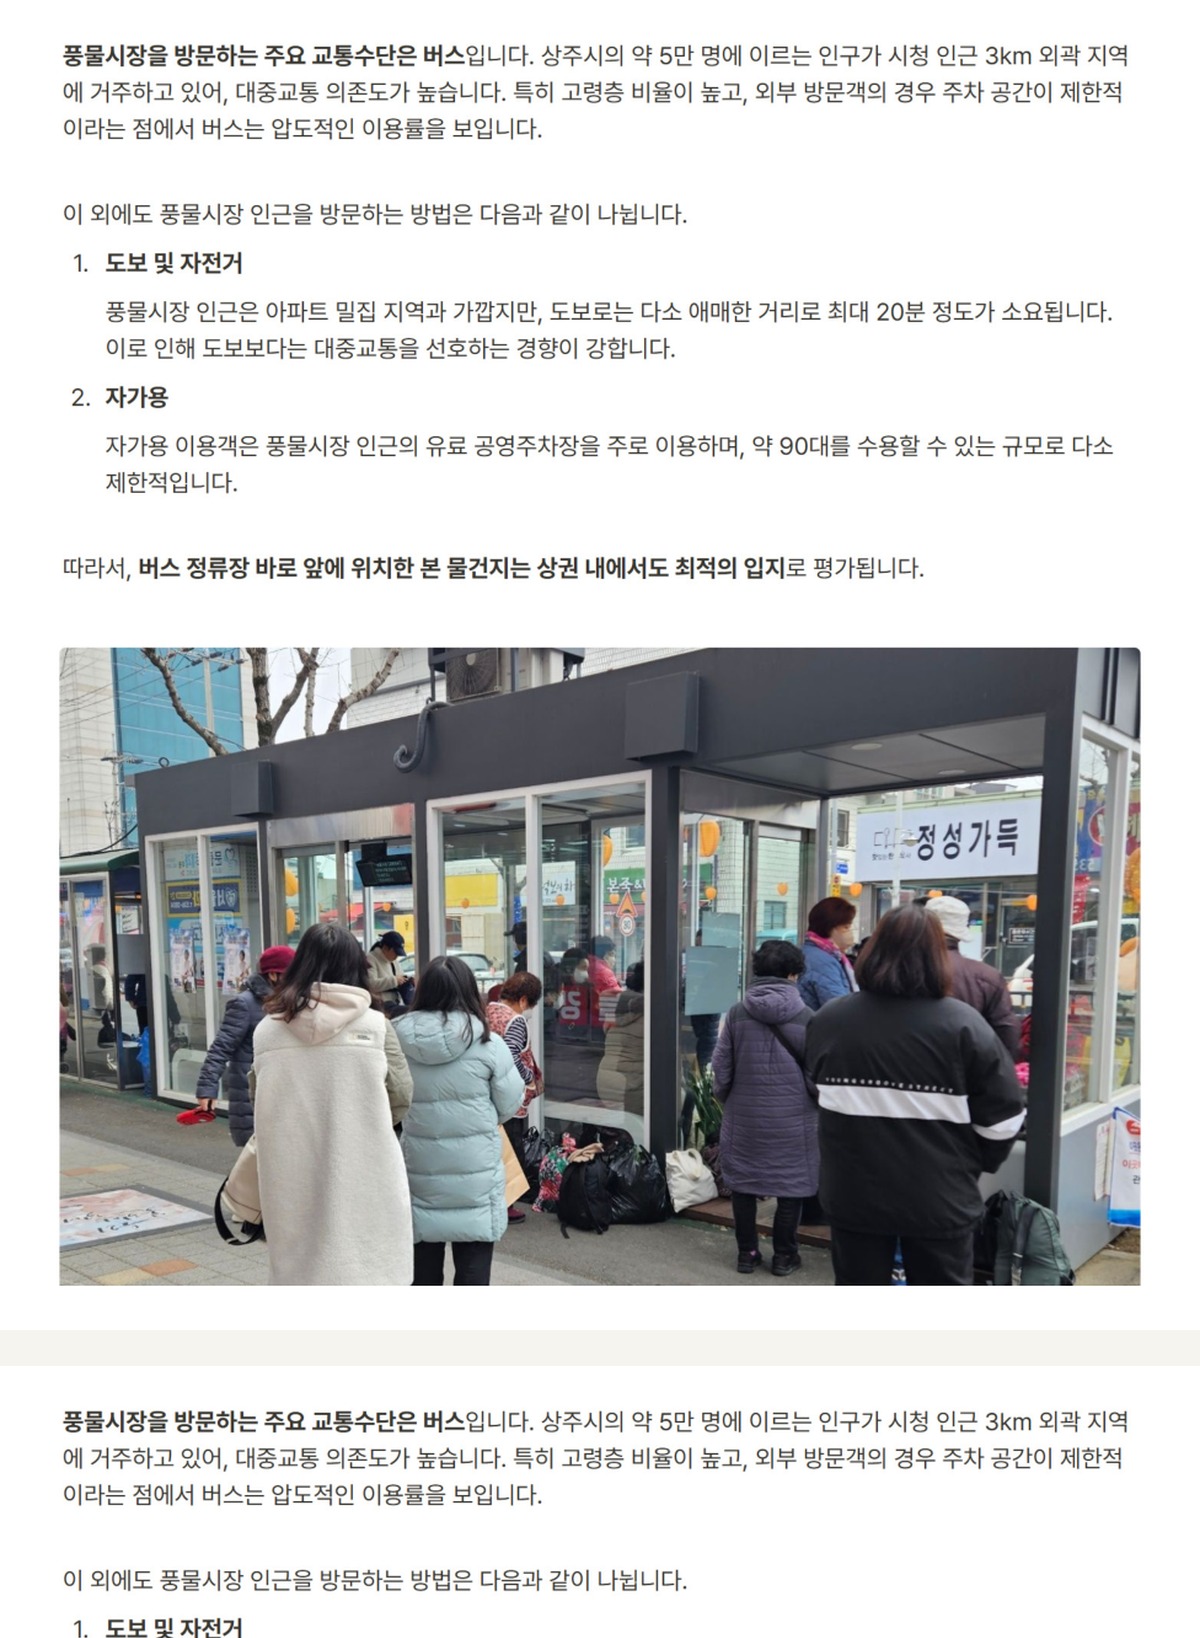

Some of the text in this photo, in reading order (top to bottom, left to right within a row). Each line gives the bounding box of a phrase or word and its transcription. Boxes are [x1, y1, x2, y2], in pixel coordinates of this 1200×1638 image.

[63, 44, 1127, 67] 풍물시장을 방문하는 주요 교통수단은 버스입니다. 상주시의 약 5만 명에 이르는 인구가 시청 인근 3km 외곽 지역
[74, 252, 241, 274] 1. 도보 및 자전거
[72, 386, 168, 408] 2. 자가용
[64, 557, 923, 581] 따라서, 버스 정류장 바로 앞에 위치한 본 물건지는 상권 내에서도 최적의 입지로 평가됩니다.
[917, 818, 1019, 861] 정성가득
[64, 1570, 686, 1591] 이 외에도 풍물시장 인근을 방문하는 방법은 다음과 같이 나뉩니다.
